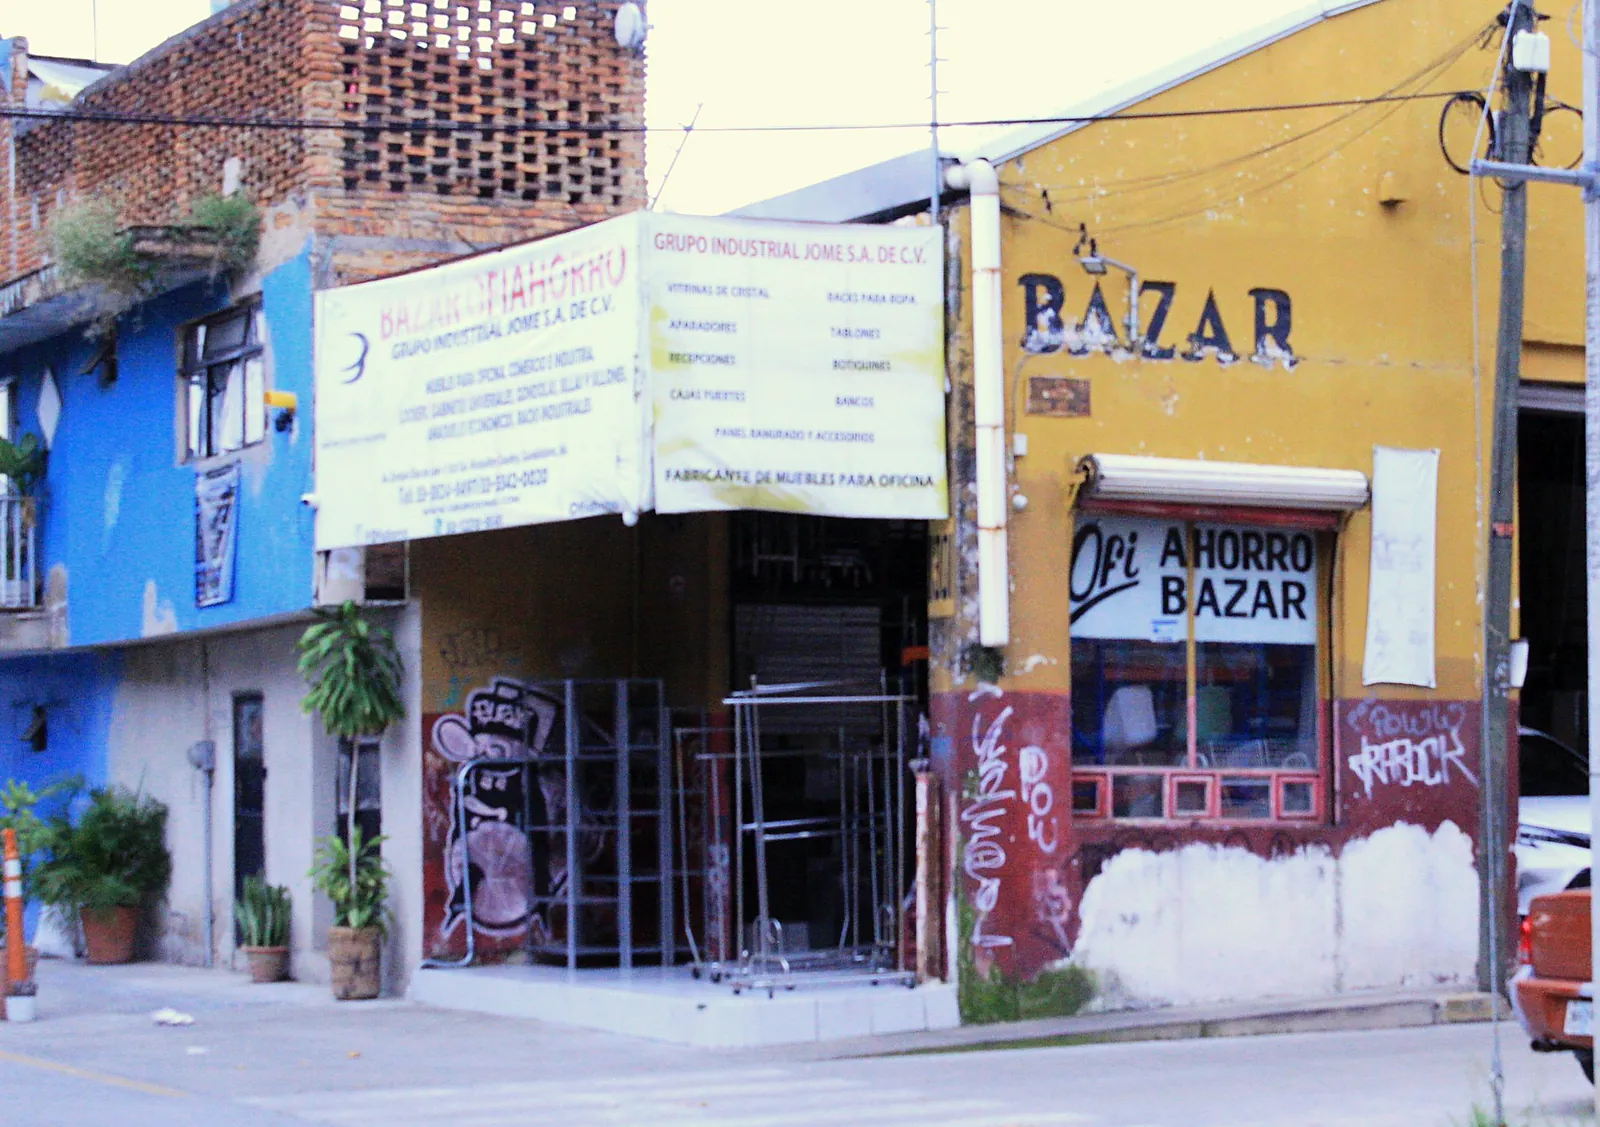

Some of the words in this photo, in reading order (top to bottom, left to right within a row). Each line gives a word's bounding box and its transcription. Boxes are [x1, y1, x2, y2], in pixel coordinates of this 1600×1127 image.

[654, 232, 707, 254] GRUPO
[711, 237, 800, 260] INDUSTRIAL
[804, 242, 843, 262] JOME
[847, 245, 873, 263] S.A.
[878, 246, 896, 264] DE
[900, 247, 926, 265] C.V.
[667, 282, 713, 296] VITRINAS
[731, 286, 770, 299] CRISTAL
[669, 320, 738, 334] APARADORES
[1018, 272, 1304, 368] BAZAR
[392, 338, 432, 361] GRUPO
[434, 323, 503, 351] INDUSTRIAL
[507, 312, 540, 335] JOME
[570, 301, 587, 321] DE
[831, 327, 881, 340] TABLONES
[668, 351, 736, 366] RECEPCIONES
[833, 358, 891, 372] BOTIQUINES
[669, 388, 701, 401] CAJAS
[703, 389, 746, 403] FUERTES
[835, 396, 875, 409] BANCOS
[816, 430, 875, 444] ACCESORIOS
[665, 467, 750, 485] FABRICANTE
[755, 470, 772, 485] DE
[776, 471, 835, 486] MUEBLES
[839, 473, 875, 487] PARA
[879, 474, 935, 488] OFICINA
[1069, 521, 1140, 602] Ofi
[1160, 526, 1313, 573] AHORRO
[1161, 575, 1307, 620] BAZAR
